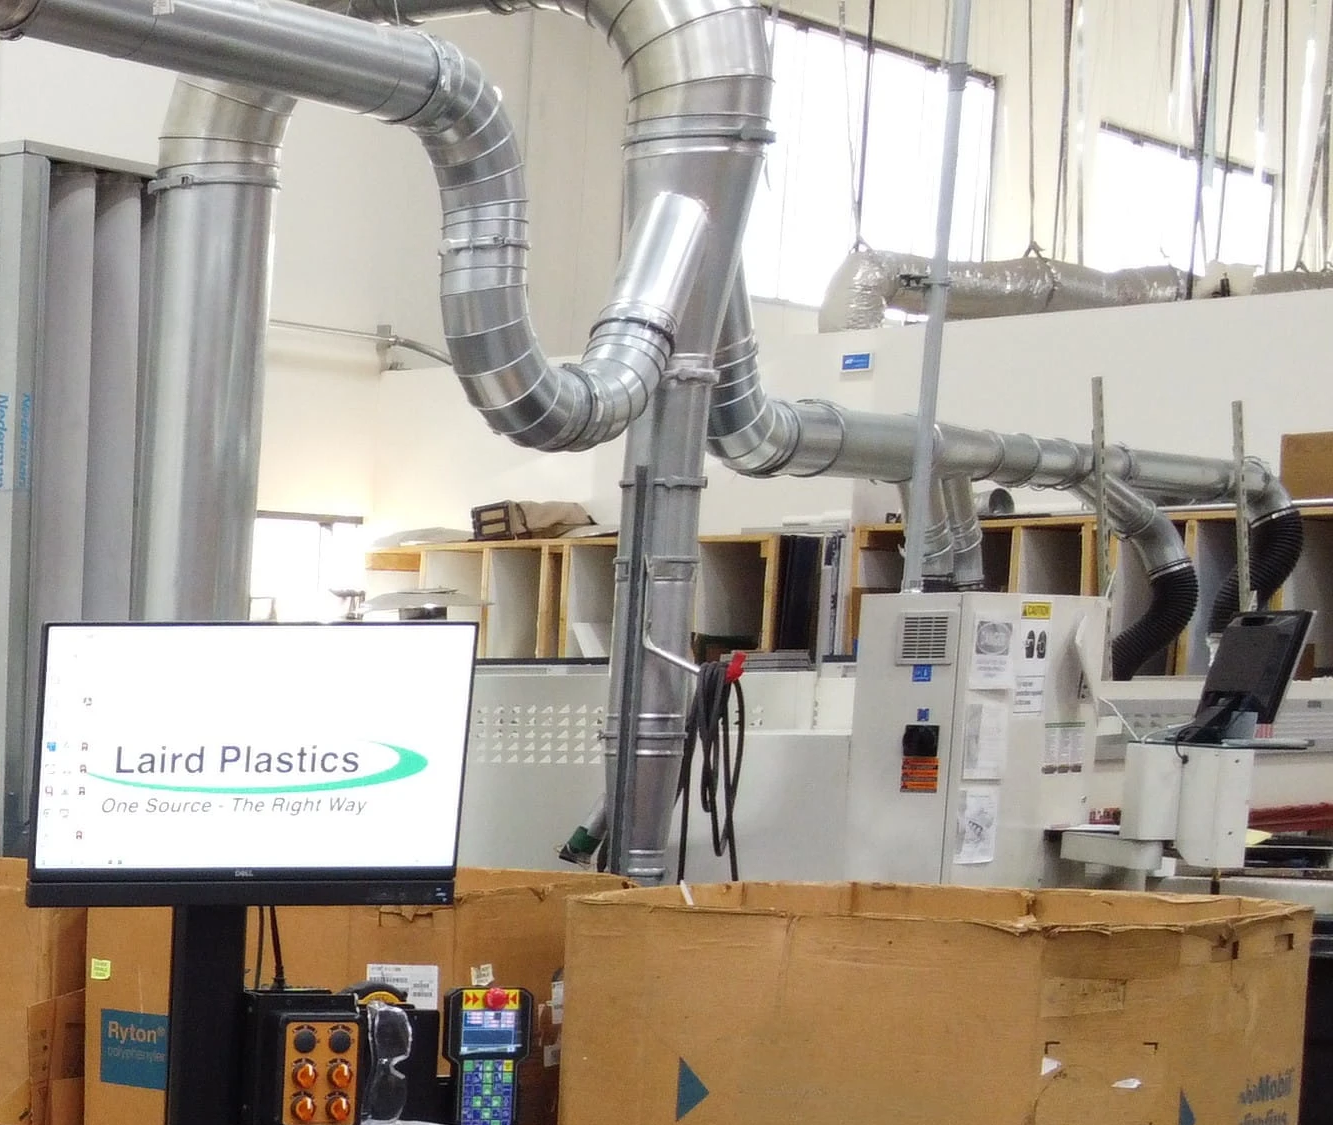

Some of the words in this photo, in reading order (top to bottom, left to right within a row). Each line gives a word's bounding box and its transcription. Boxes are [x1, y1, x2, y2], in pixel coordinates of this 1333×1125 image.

[19, 392, 31, 488] Nederman
[115, 746, 204, 773] Laird
[219, 745, 360, 773] Plastics
[101, 798, 139, 813] One
[145, 797, 212, 813] Source
[233, 797, 265, 812] The
[271, 796, 321, 816] Right
[329, 797, 368, 816] Way
